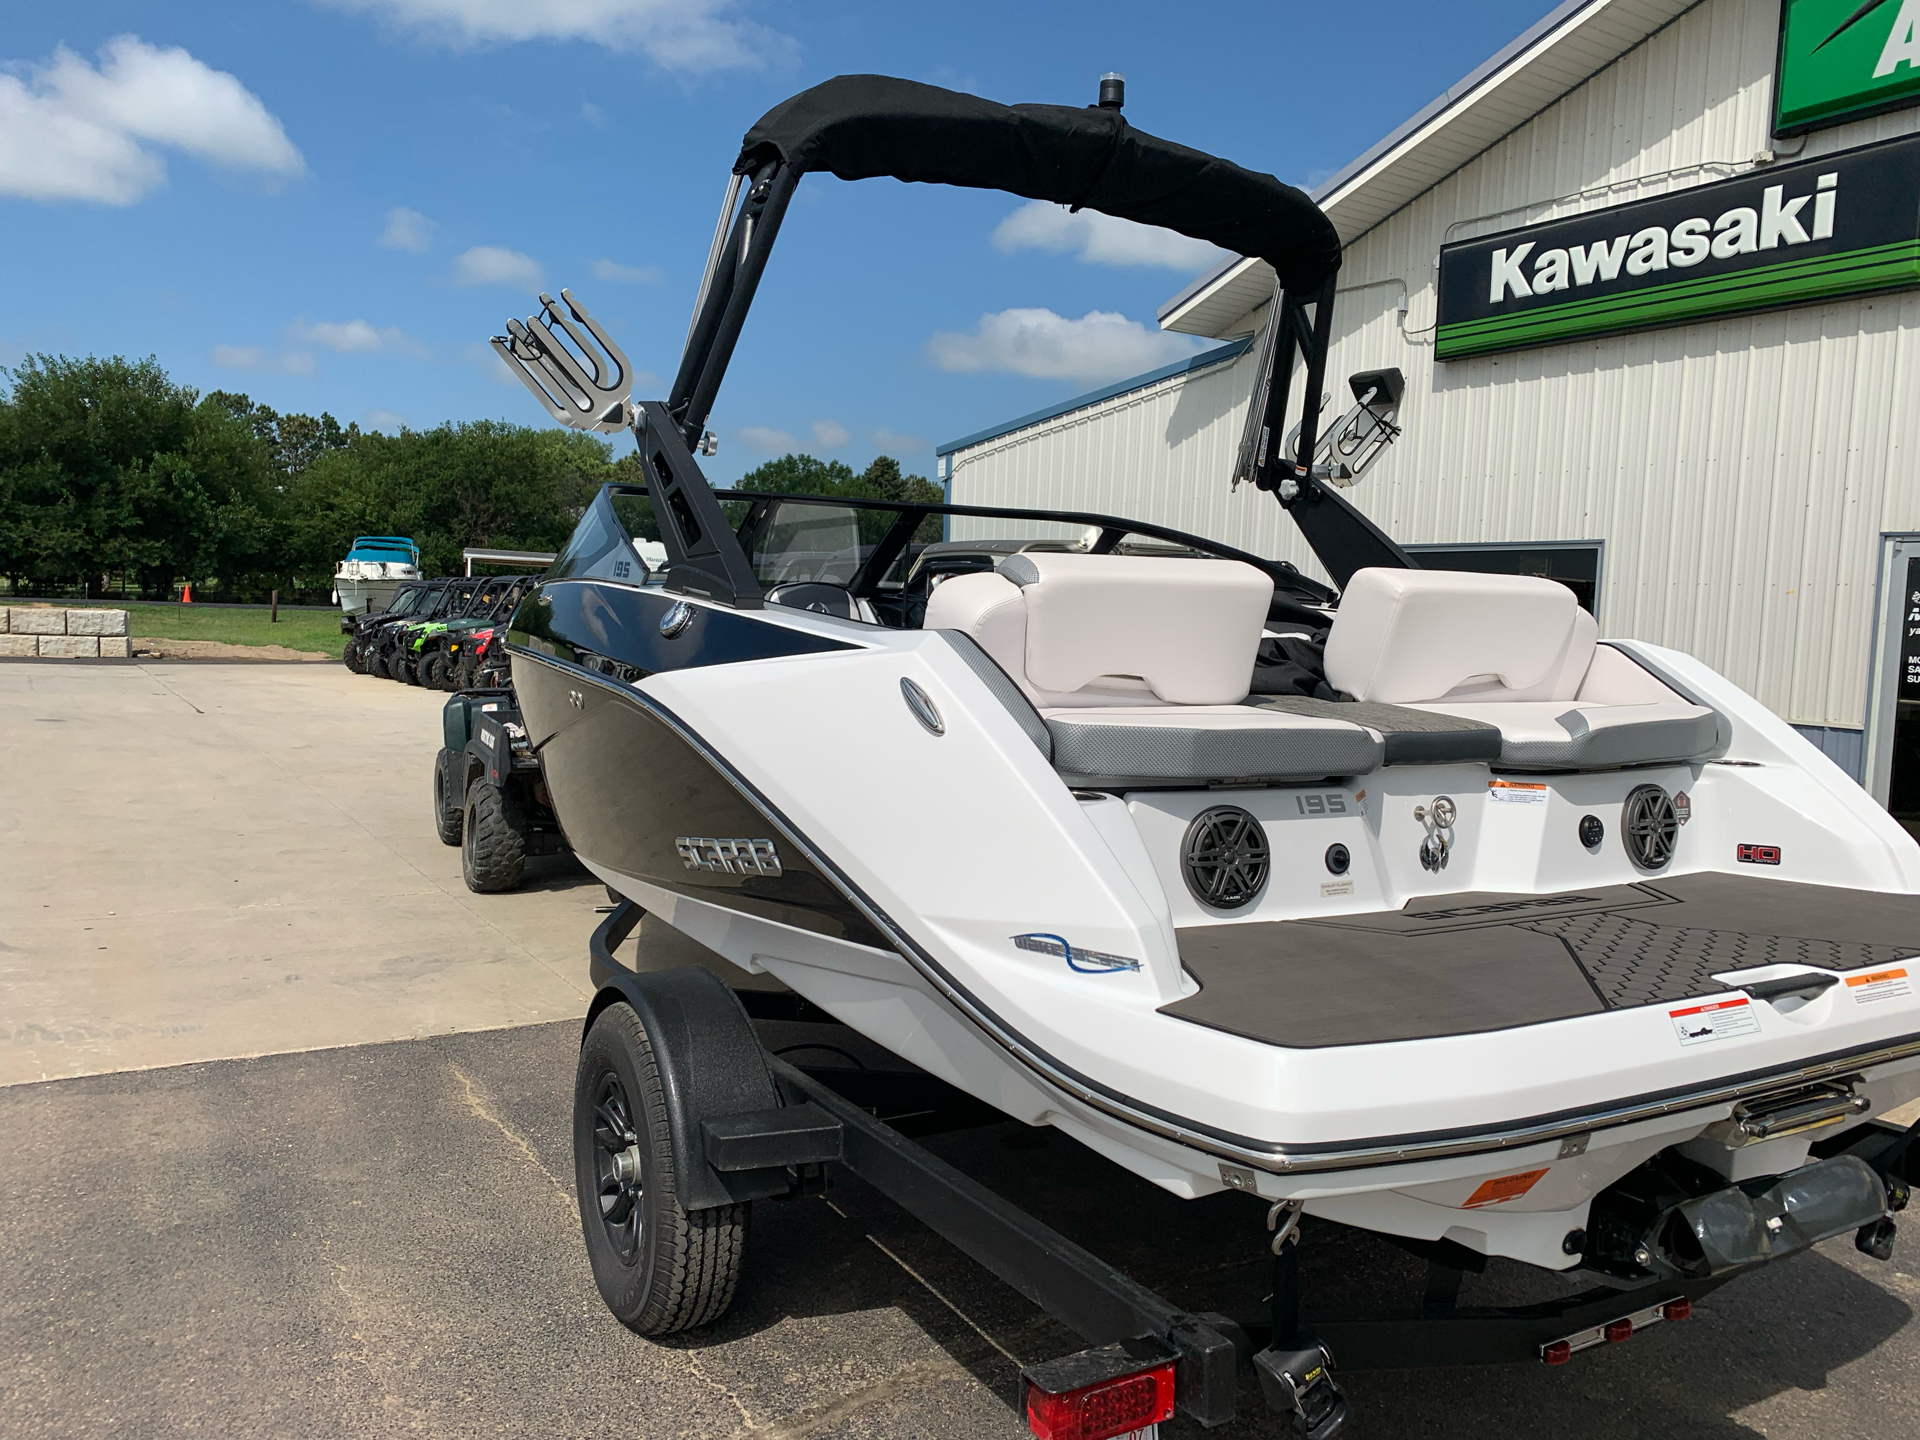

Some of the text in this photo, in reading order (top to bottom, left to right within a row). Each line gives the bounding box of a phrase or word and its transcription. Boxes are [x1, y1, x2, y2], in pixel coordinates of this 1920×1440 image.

[1490, 172, 1838, 303] Kawasaki
[613, 560, 631, 578] 195
[1295, 794, 1346, 815] 195
[675, 836, 782, 878] SCARAB
[1739, 845, 1780, 860] HO
